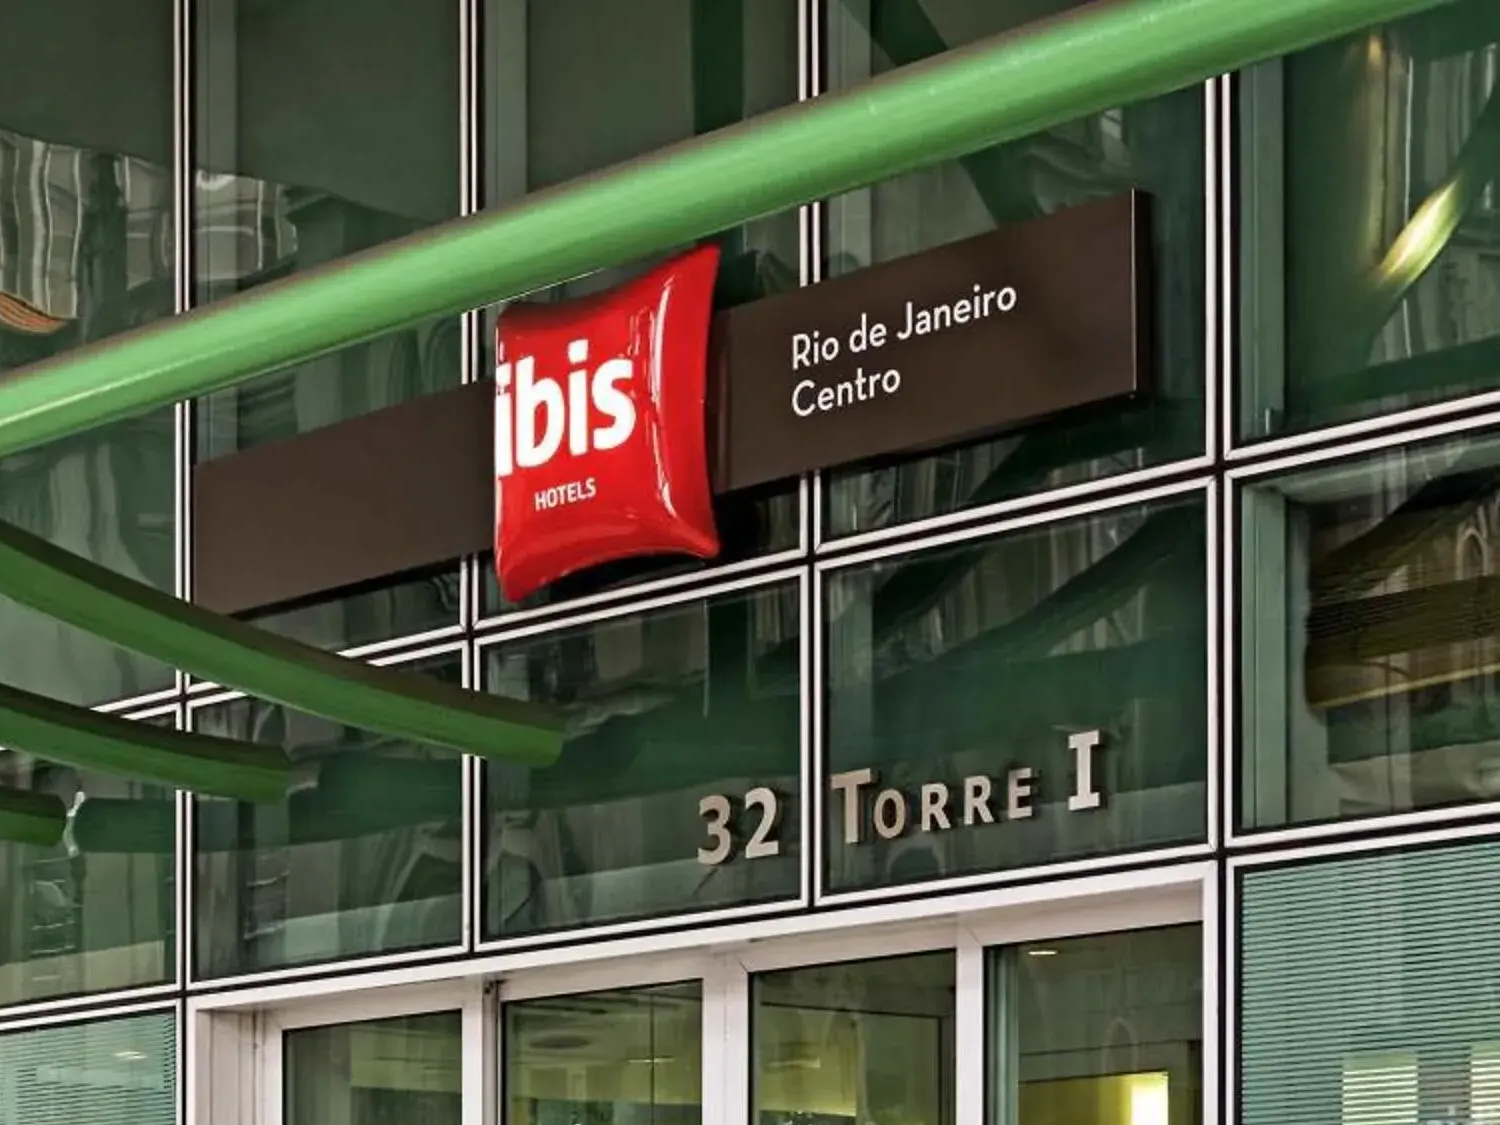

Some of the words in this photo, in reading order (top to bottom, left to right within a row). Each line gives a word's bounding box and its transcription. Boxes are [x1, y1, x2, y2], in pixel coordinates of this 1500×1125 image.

[792, 331, 839, 370] Rio
[849, 312, 888, 353] de
[897, 284, 1017, 340] Janeiro
[495, 338, 637, 477] ibis
[791, 367, 900, 417] Centro
[534, 477, 597, 511] HOTELS
[697, 787, 779, 865] 32
[1067, 729, 1100, 811] I
